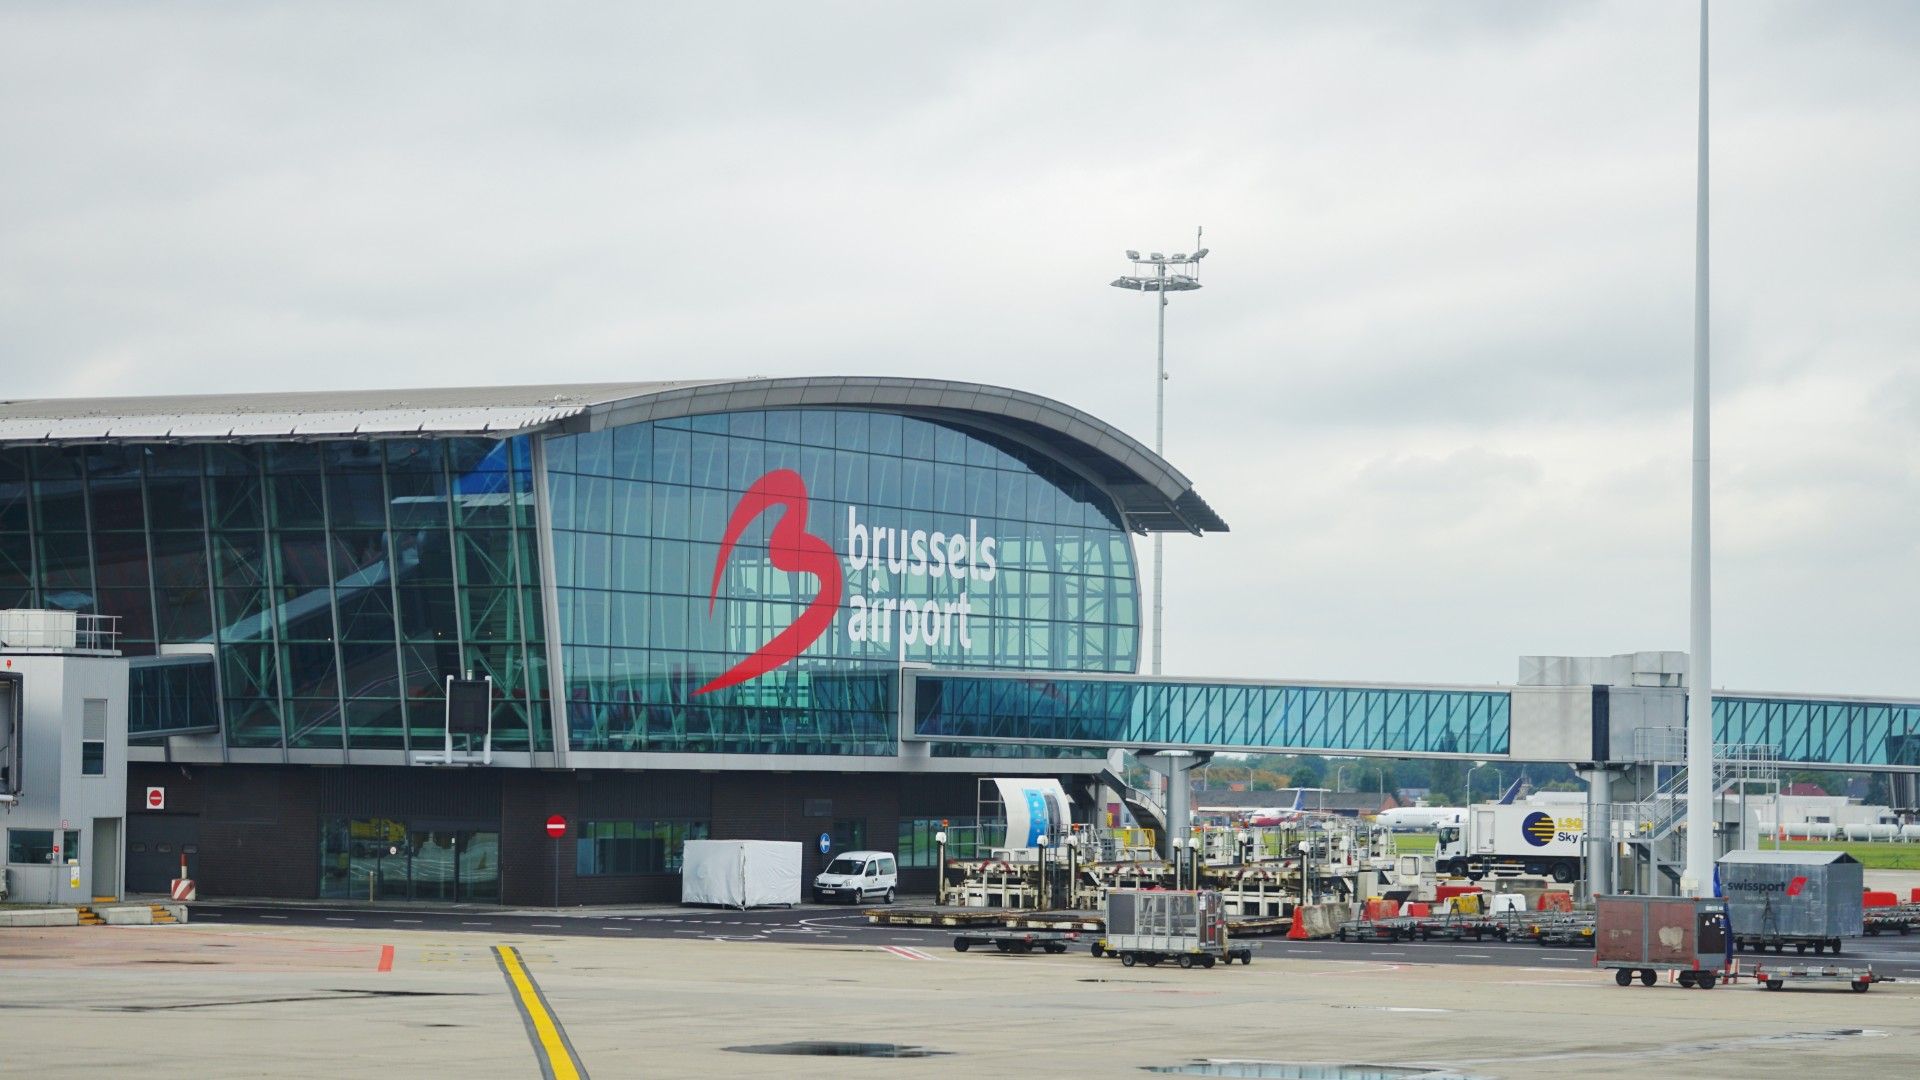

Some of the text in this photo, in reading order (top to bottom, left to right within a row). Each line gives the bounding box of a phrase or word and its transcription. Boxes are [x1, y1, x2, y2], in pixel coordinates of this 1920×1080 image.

[848, 505, 996, 582] brussels
[848, 577, 972, 662] airport
[1558, 832, 1578, 843] Sky
[1728, 879, 1785, 893] swissport
